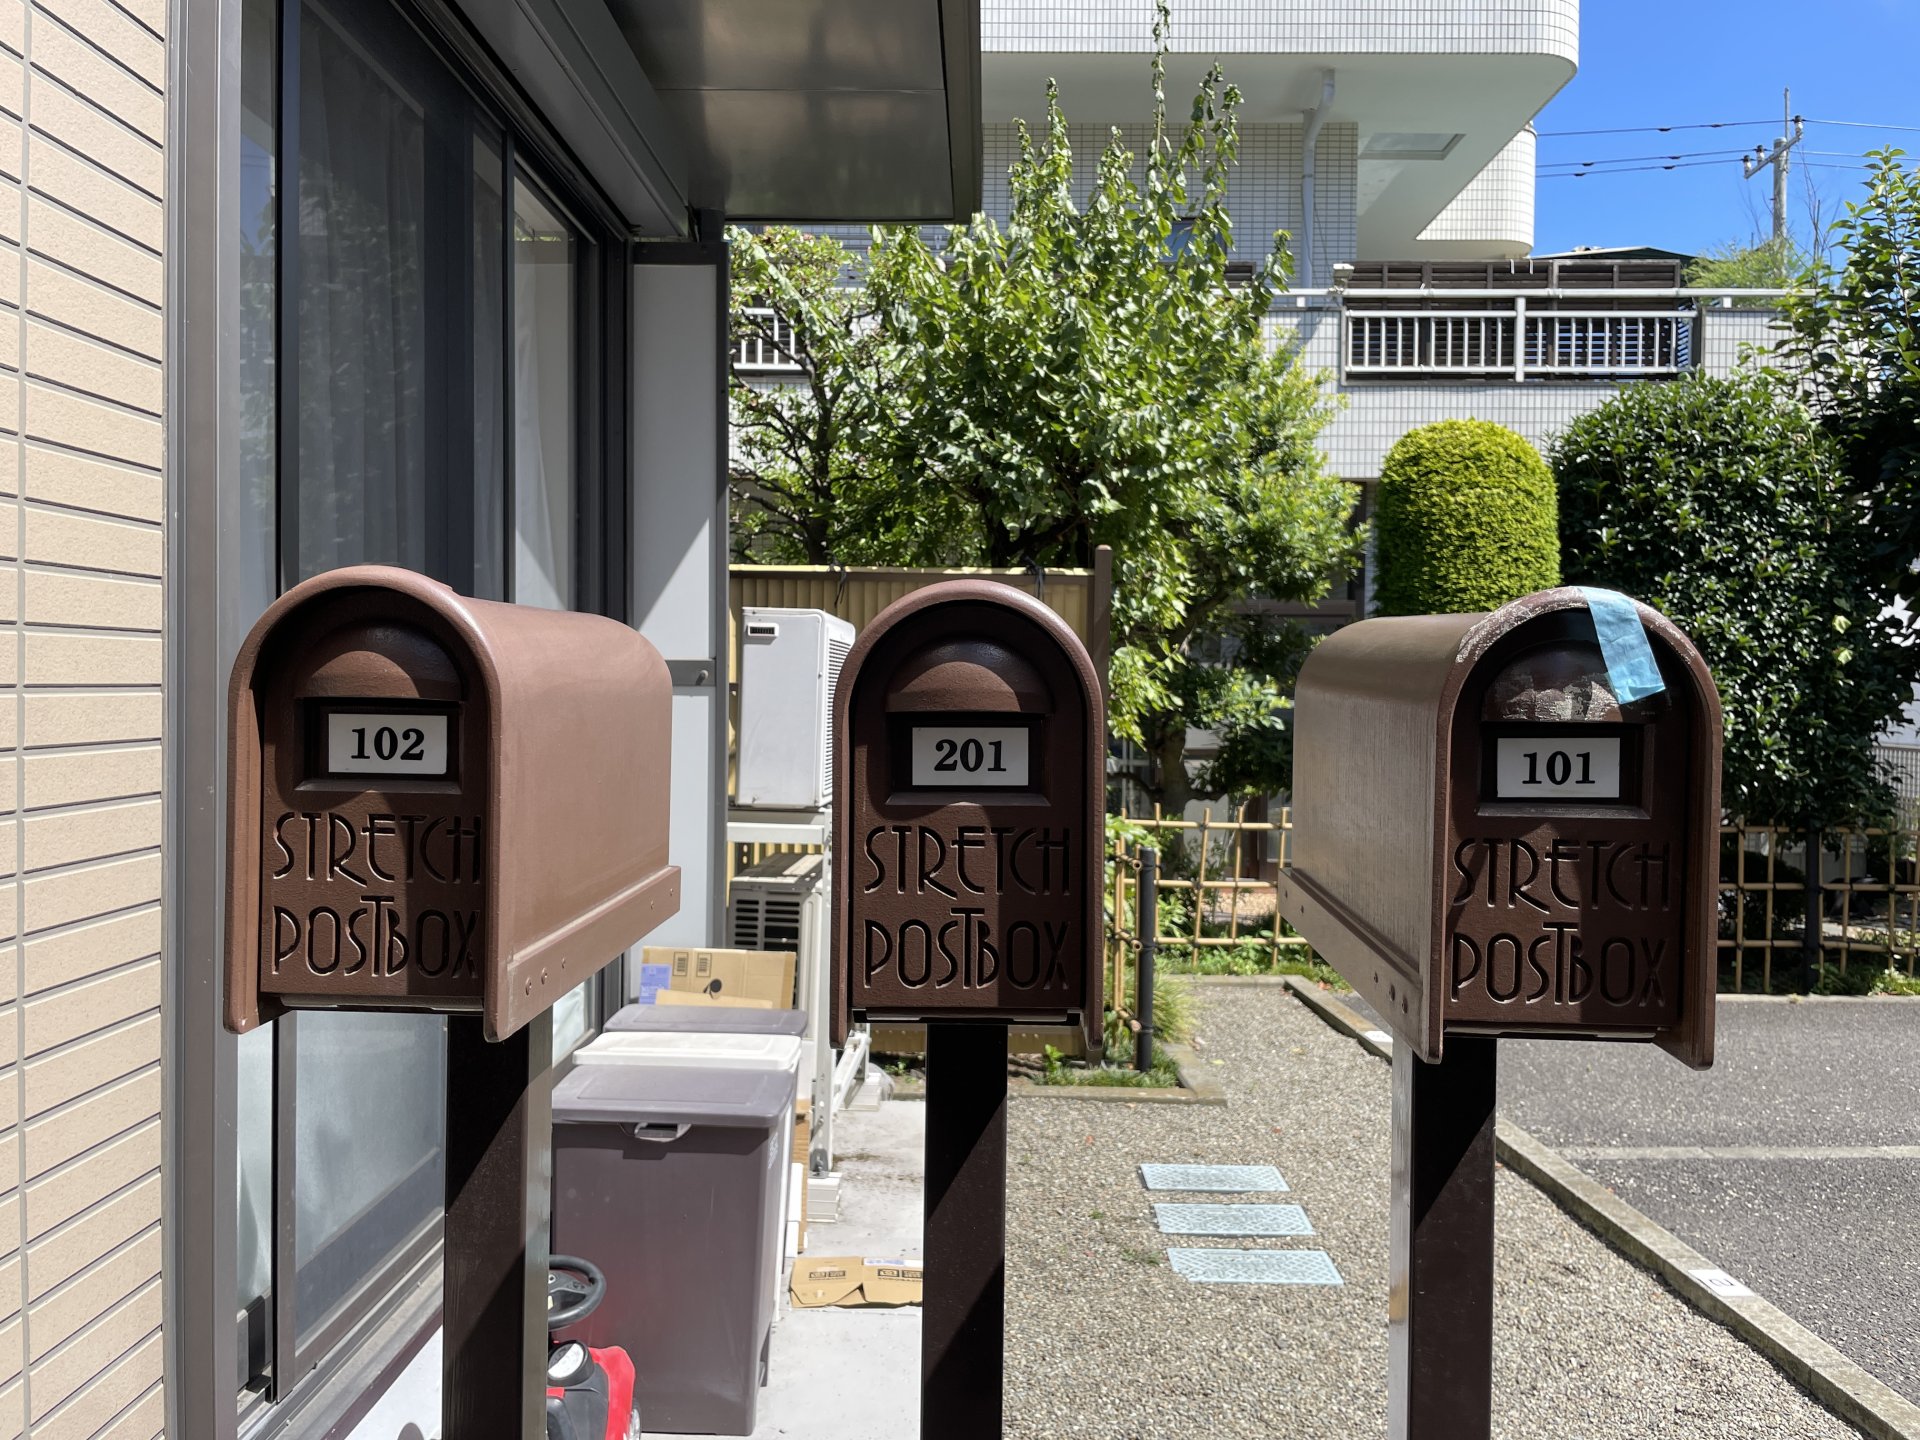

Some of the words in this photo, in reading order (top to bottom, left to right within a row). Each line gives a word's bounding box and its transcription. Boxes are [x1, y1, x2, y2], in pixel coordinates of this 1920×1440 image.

[351, 726, 425, 762] 102
[934, 738, 1007, 773] 201
[1521, 749, 1597, 786] 101
[272, 811, 481, 887] STRETCH
[863, 825, 1071, 899] STRETCH
[1453, 837, 1669, 914] STRETCH
[272, 895, 480, 979] POSTBOX
[863, 906, 1070, 990] POSTBOX
[1450, 921, 1667, 1008] POSTBOX
